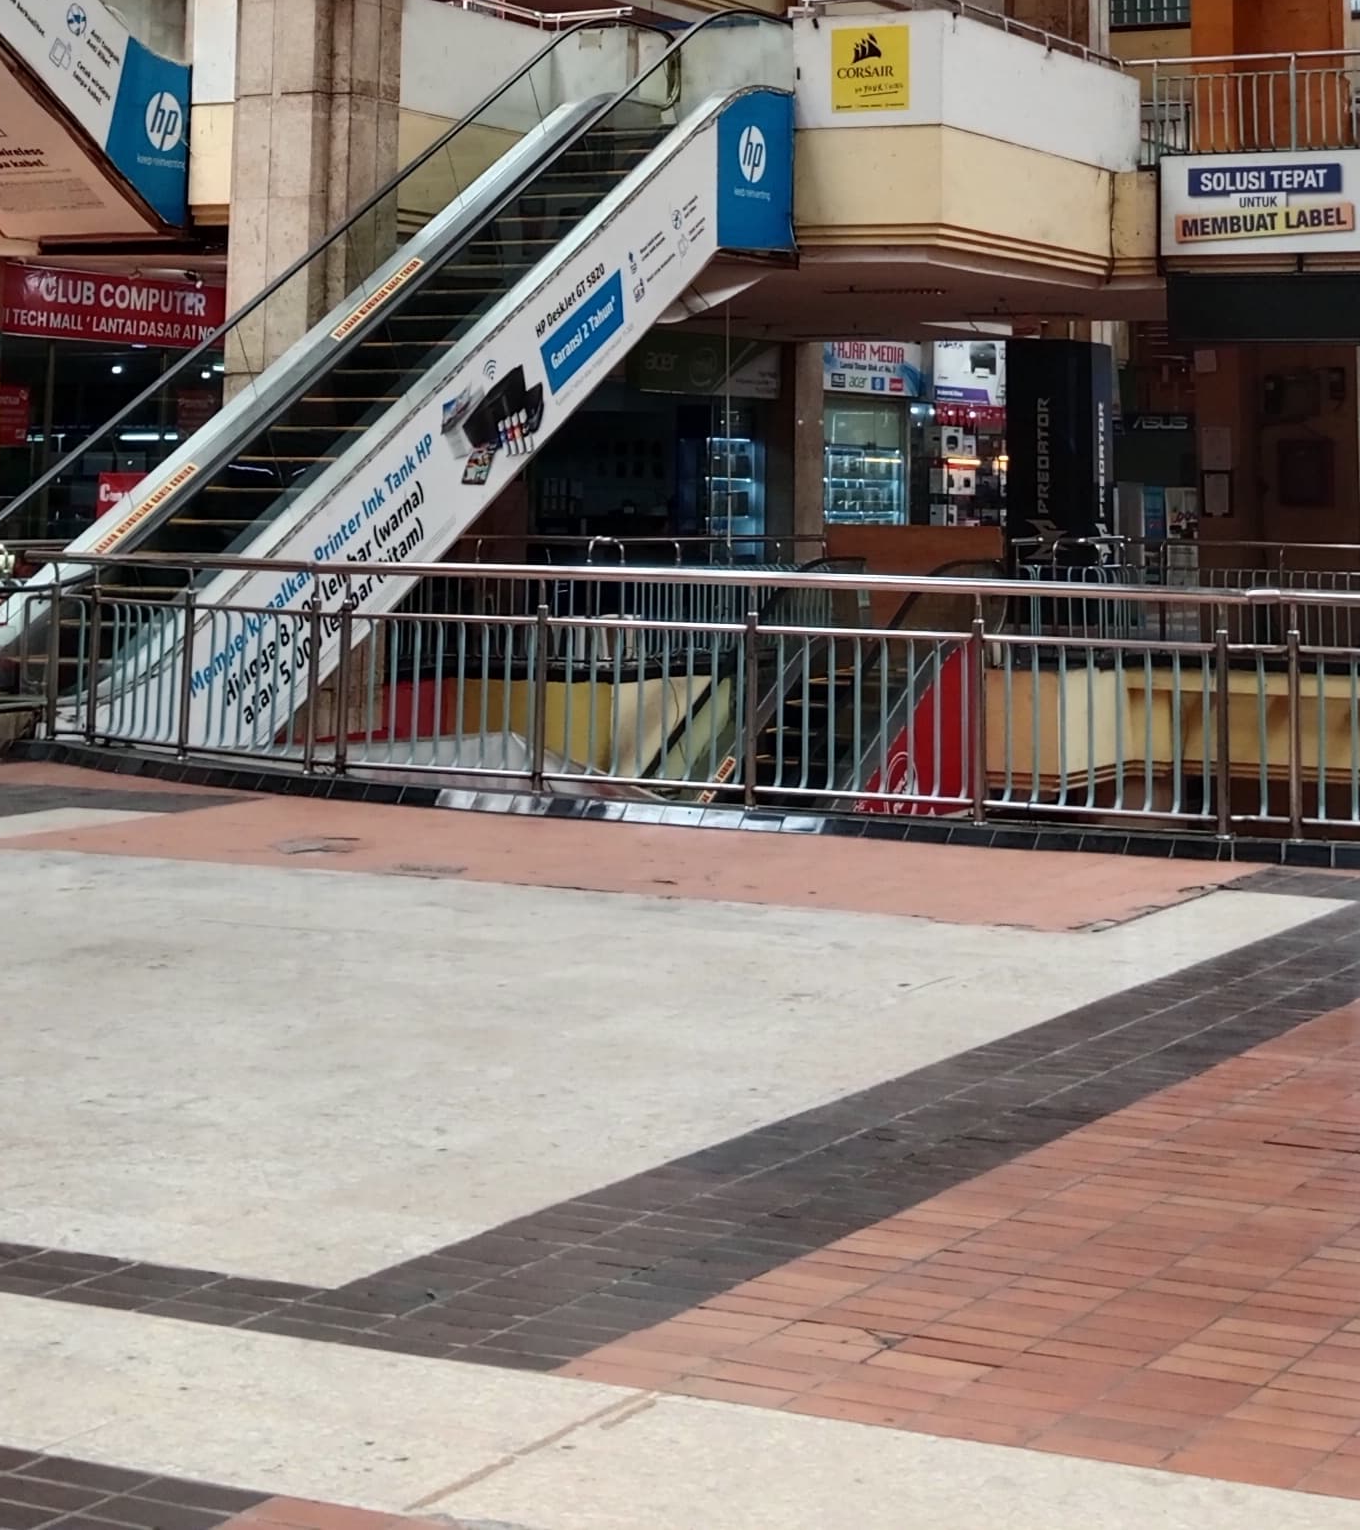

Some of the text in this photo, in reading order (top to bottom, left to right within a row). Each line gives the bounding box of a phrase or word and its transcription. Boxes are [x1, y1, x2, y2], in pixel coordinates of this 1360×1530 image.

[837, 65, 894, 79] CORSAIR
[147, 92, 181, 151] hp
[740, 126, 765, 183] hp
[1200, 169, 1327, 192] SOLUSI TEPAT
[1239, 196, 1278, 208] UNTUK
[1181, 207, 1347, 238] MEMBUAT LABEL
[41, 278, 207, 317] CLUB COMPUTER
[12, 308, 48, 328] TECH
[49, 313, 84, 331] MALL
[93, 316, 137, 335] LANTAI
[139, 319, 181, 339] DASAR
[535, 294, 576, 338] HP DeskJet
[551, 328, 583, 370] Garansi
[644, 351, 677, 370] acer
[830, 342, 905, 363] FAJAR MEDIA
[849, 377, 868, 388] acer
[1133, 416, 1188, 429] ASUS
[1037, 398, 1050, 514] PREDATOR
[384, 456, 415, 494] Tank
